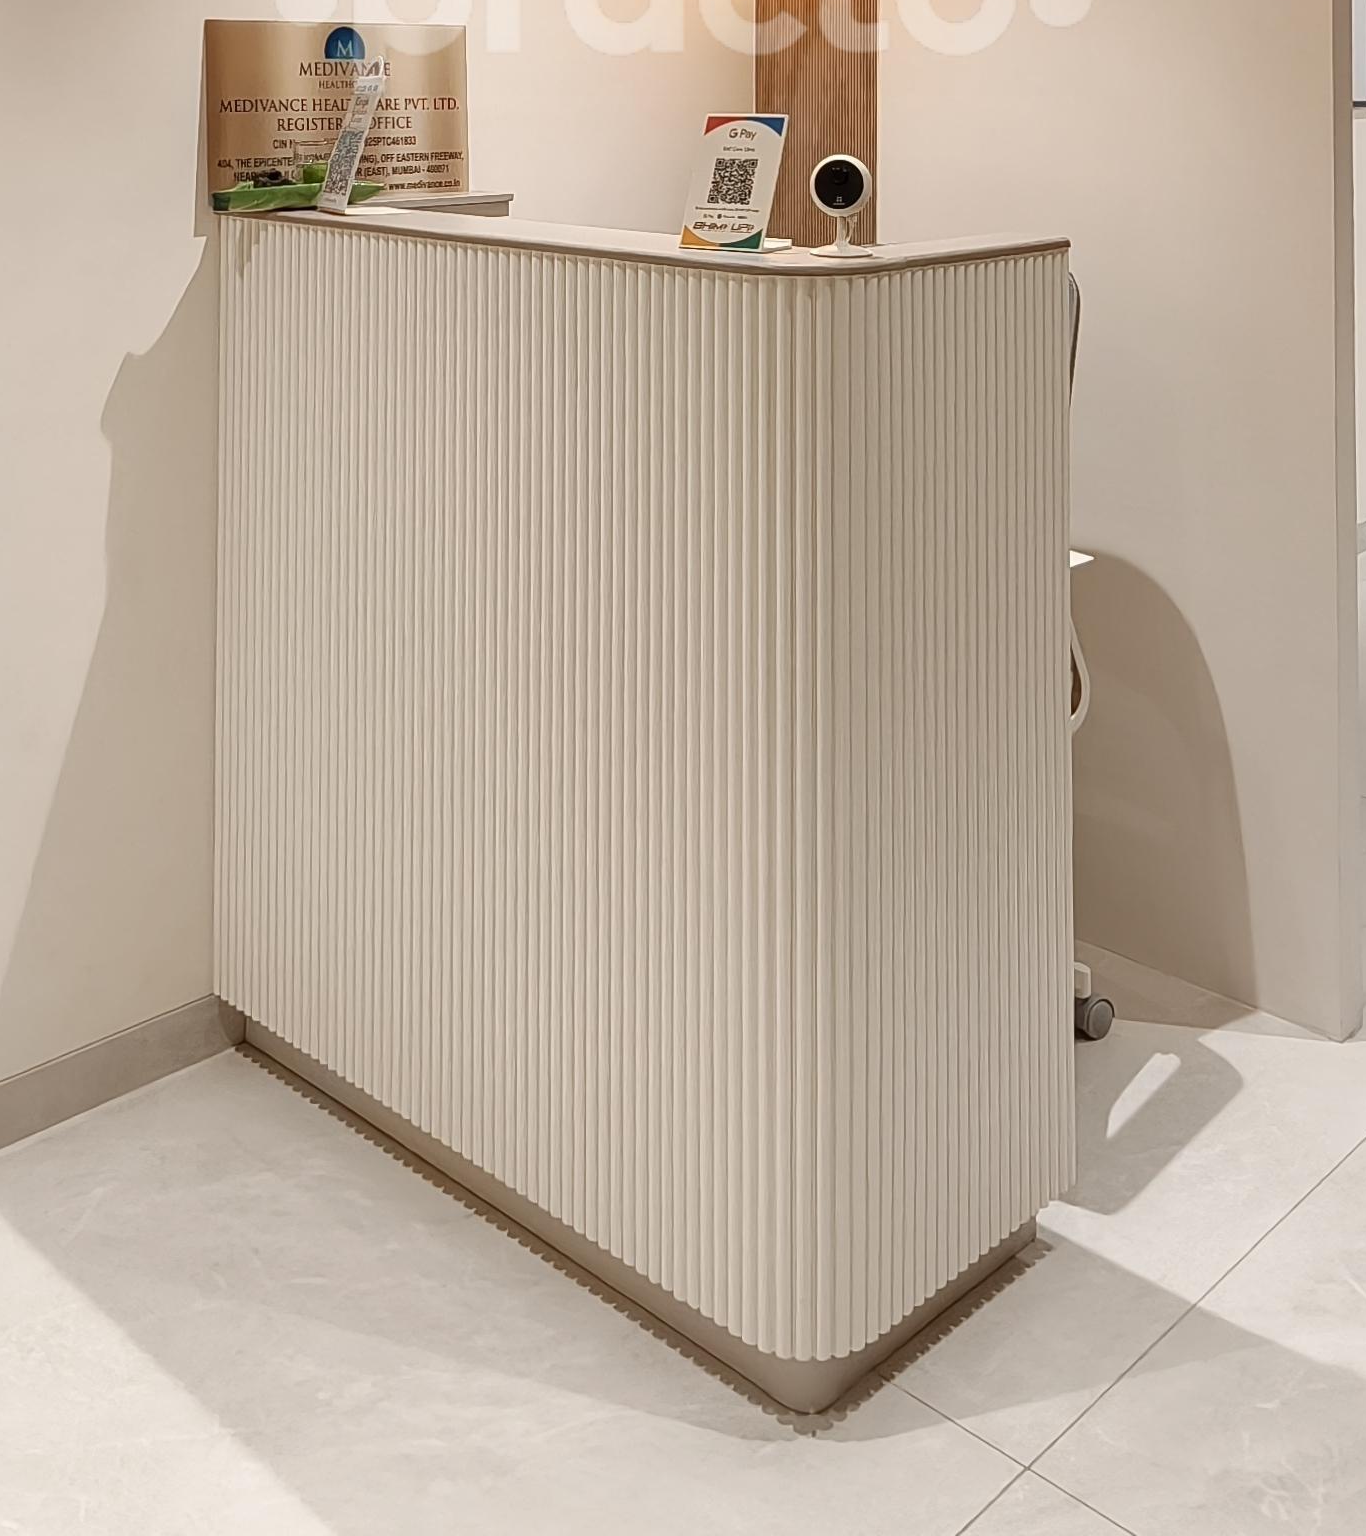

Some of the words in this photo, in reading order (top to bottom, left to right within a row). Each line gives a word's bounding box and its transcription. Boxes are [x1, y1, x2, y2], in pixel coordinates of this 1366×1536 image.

[336, 39, 354, 58] M
[298, 61, 391, 78] MEDIVANE
[219, 98, 308, 113] MEDIVANCE
[312, 97, 401, 113] HEALTARE
[404, 97, 430, 111] PVT.
[433, 97, 460, 111] LTD.
[739, 128, 757, 141] Pay
[235, 157, 253, 169] THE
[381, 152, 396, 163] OFF
[396, 151, 430, 163] EASTERN
[391, 164, 421, 175] MUMBAI
